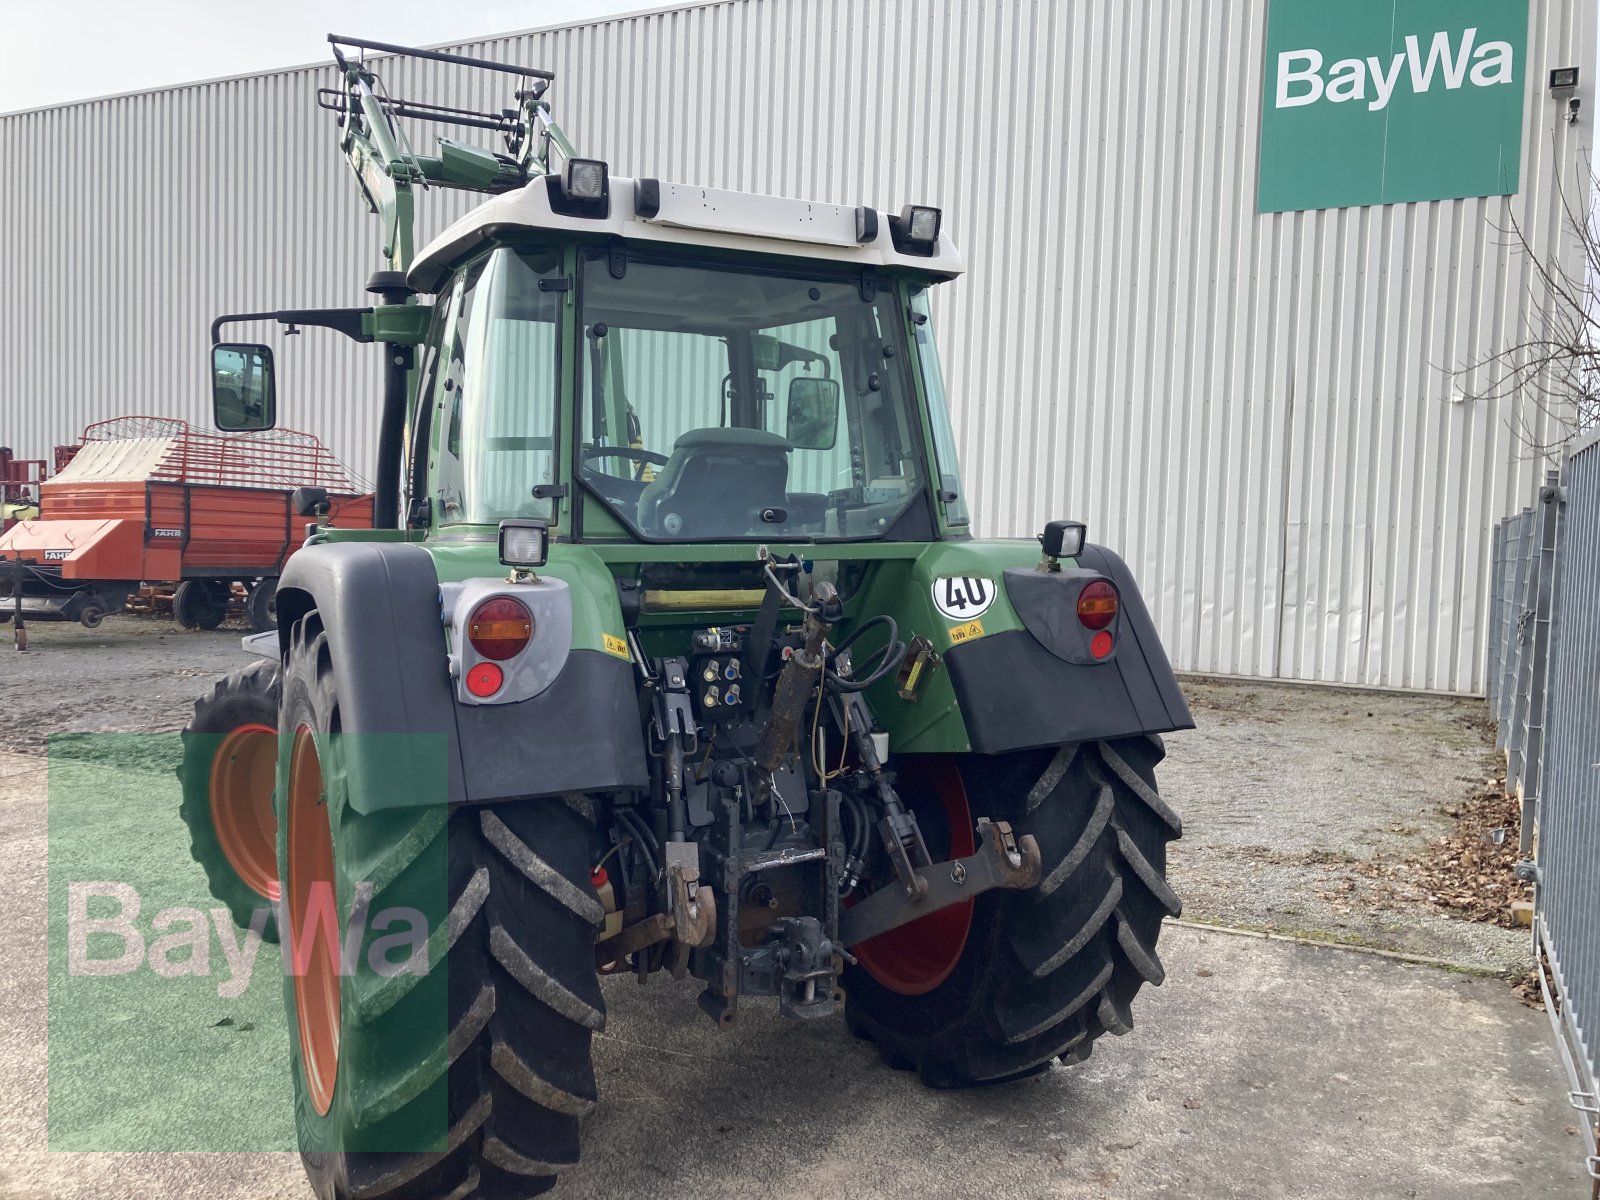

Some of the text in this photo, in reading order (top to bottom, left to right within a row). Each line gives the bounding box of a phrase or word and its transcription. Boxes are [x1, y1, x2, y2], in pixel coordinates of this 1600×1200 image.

[1275, 28, 1513, 111] BayWa
[155, 529, 181, 537] FAHR
[946, 576, 986, 610] 40
